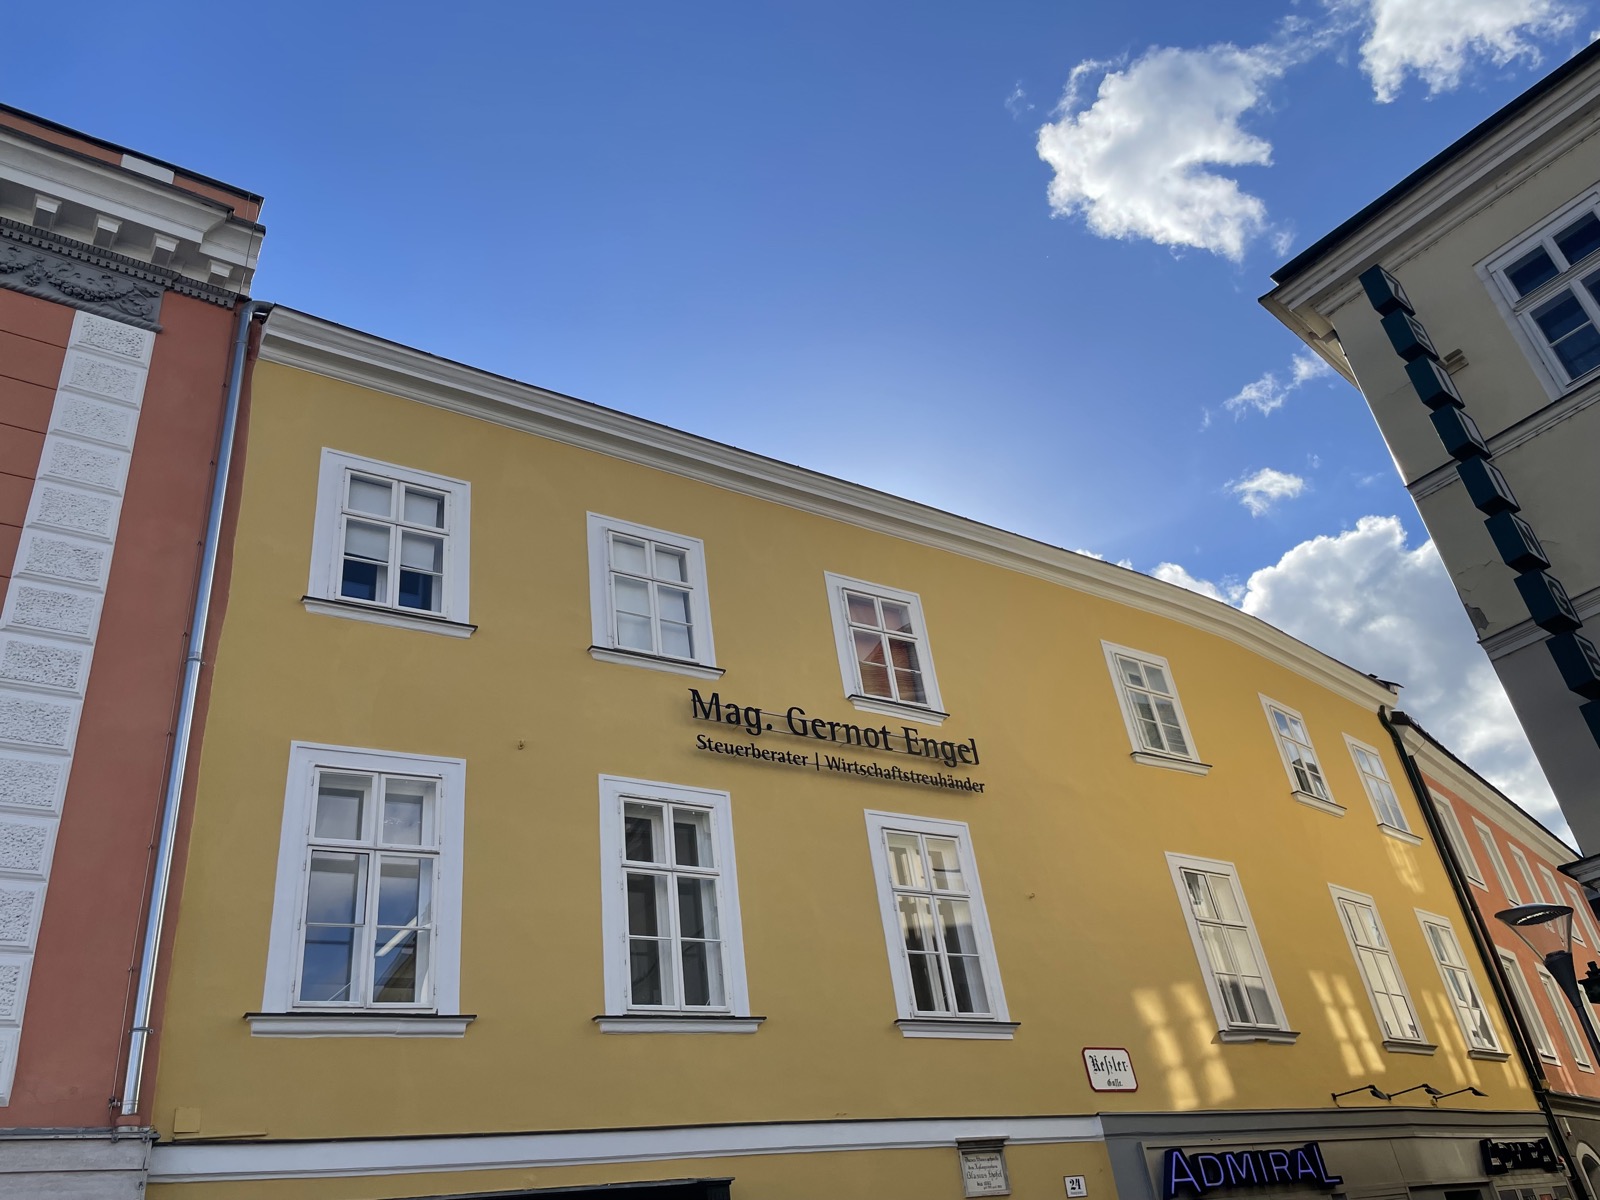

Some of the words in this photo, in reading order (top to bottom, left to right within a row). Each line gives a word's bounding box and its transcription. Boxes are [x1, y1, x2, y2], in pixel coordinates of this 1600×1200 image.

[688, 688, 773, 735] Mag.
[786, 707, 893, 751] Gernot
[901, 726, 980, 767] Engel
[696, 734, 808, 766] Steuerberater
[825, 755, 985, 793] Wirtschaftstreuhänder
[1069, 1178, 1081, 1190] 24
[1166, 1142, 1343, 1198] ADMIRAL
